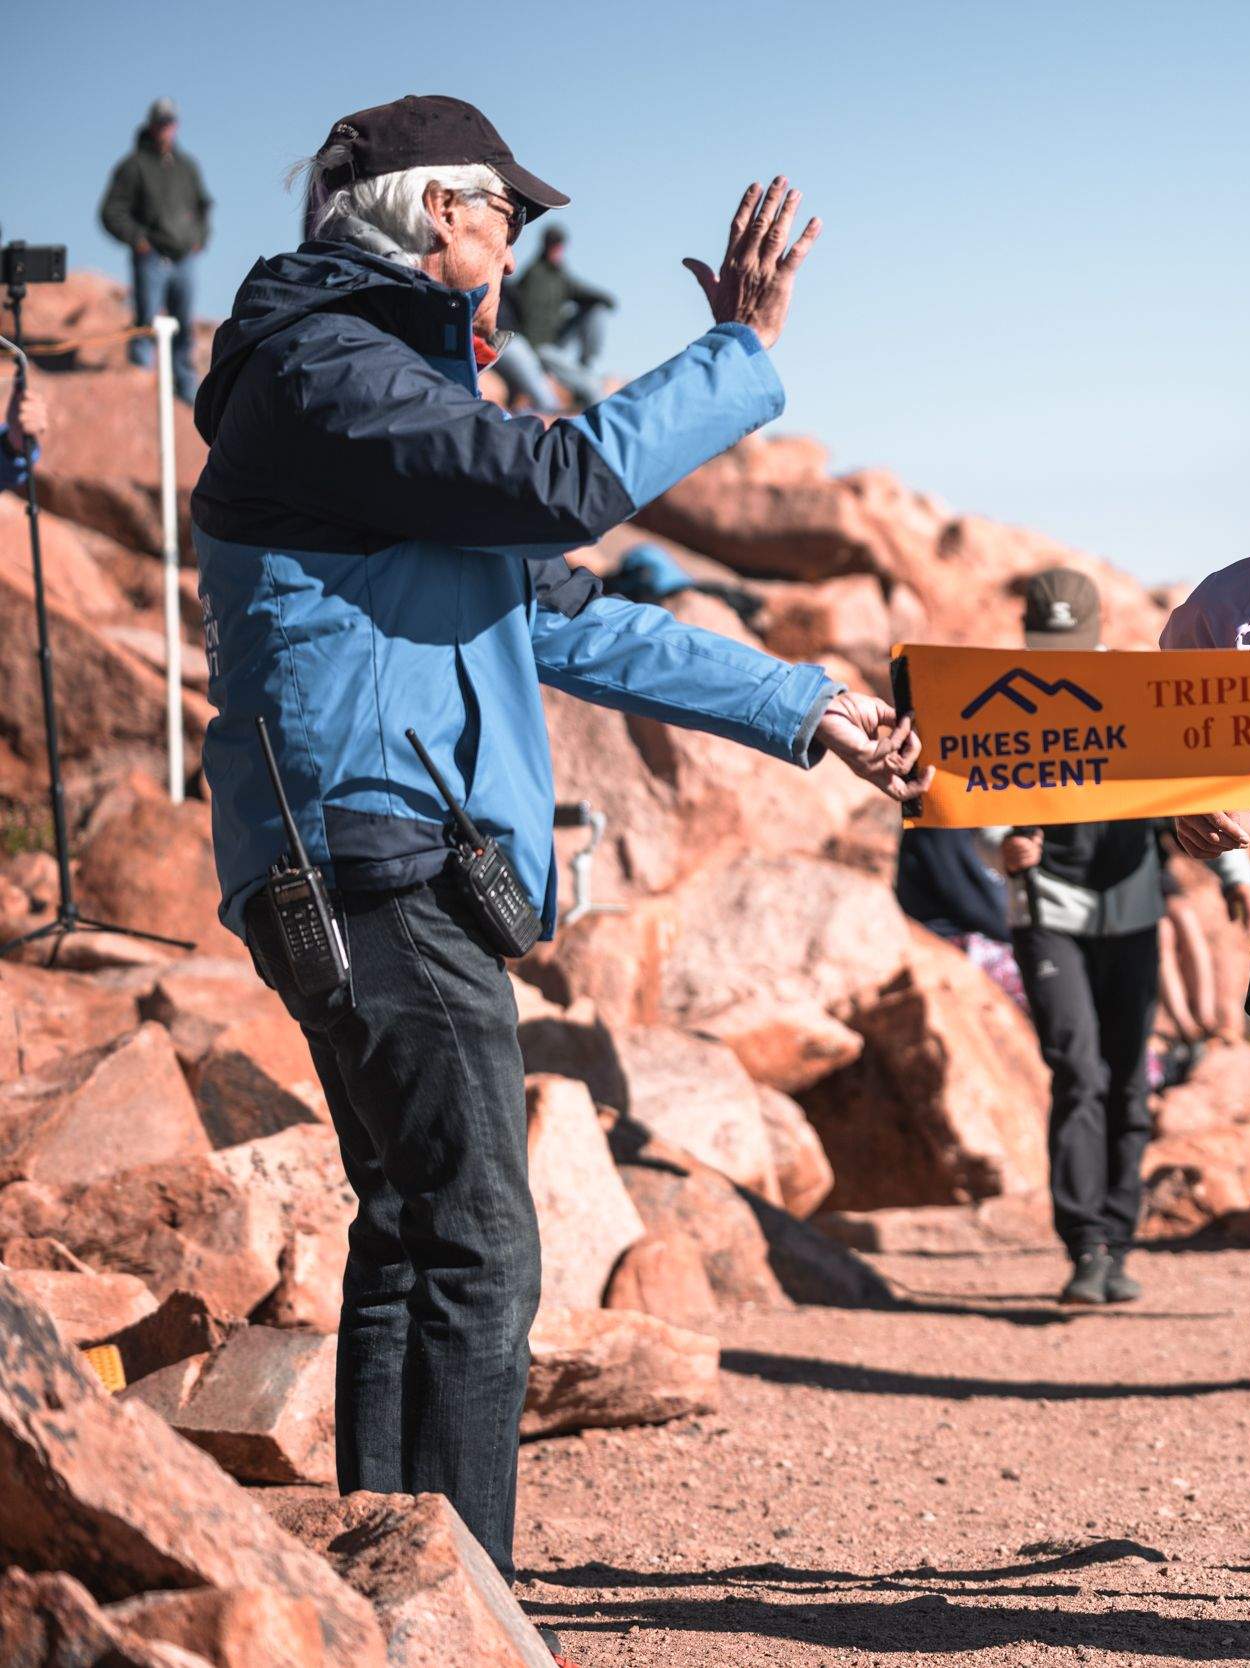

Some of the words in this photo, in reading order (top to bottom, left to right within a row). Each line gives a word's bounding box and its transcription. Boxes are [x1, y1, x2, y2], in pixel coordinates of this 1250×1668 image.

[940, 731, 1031, 761] PIKES
[1042, 724, 1128, 754] PEAK
[1182, 716, 1215, 749] of
[966, 757, 1110, 793] ASCENT
